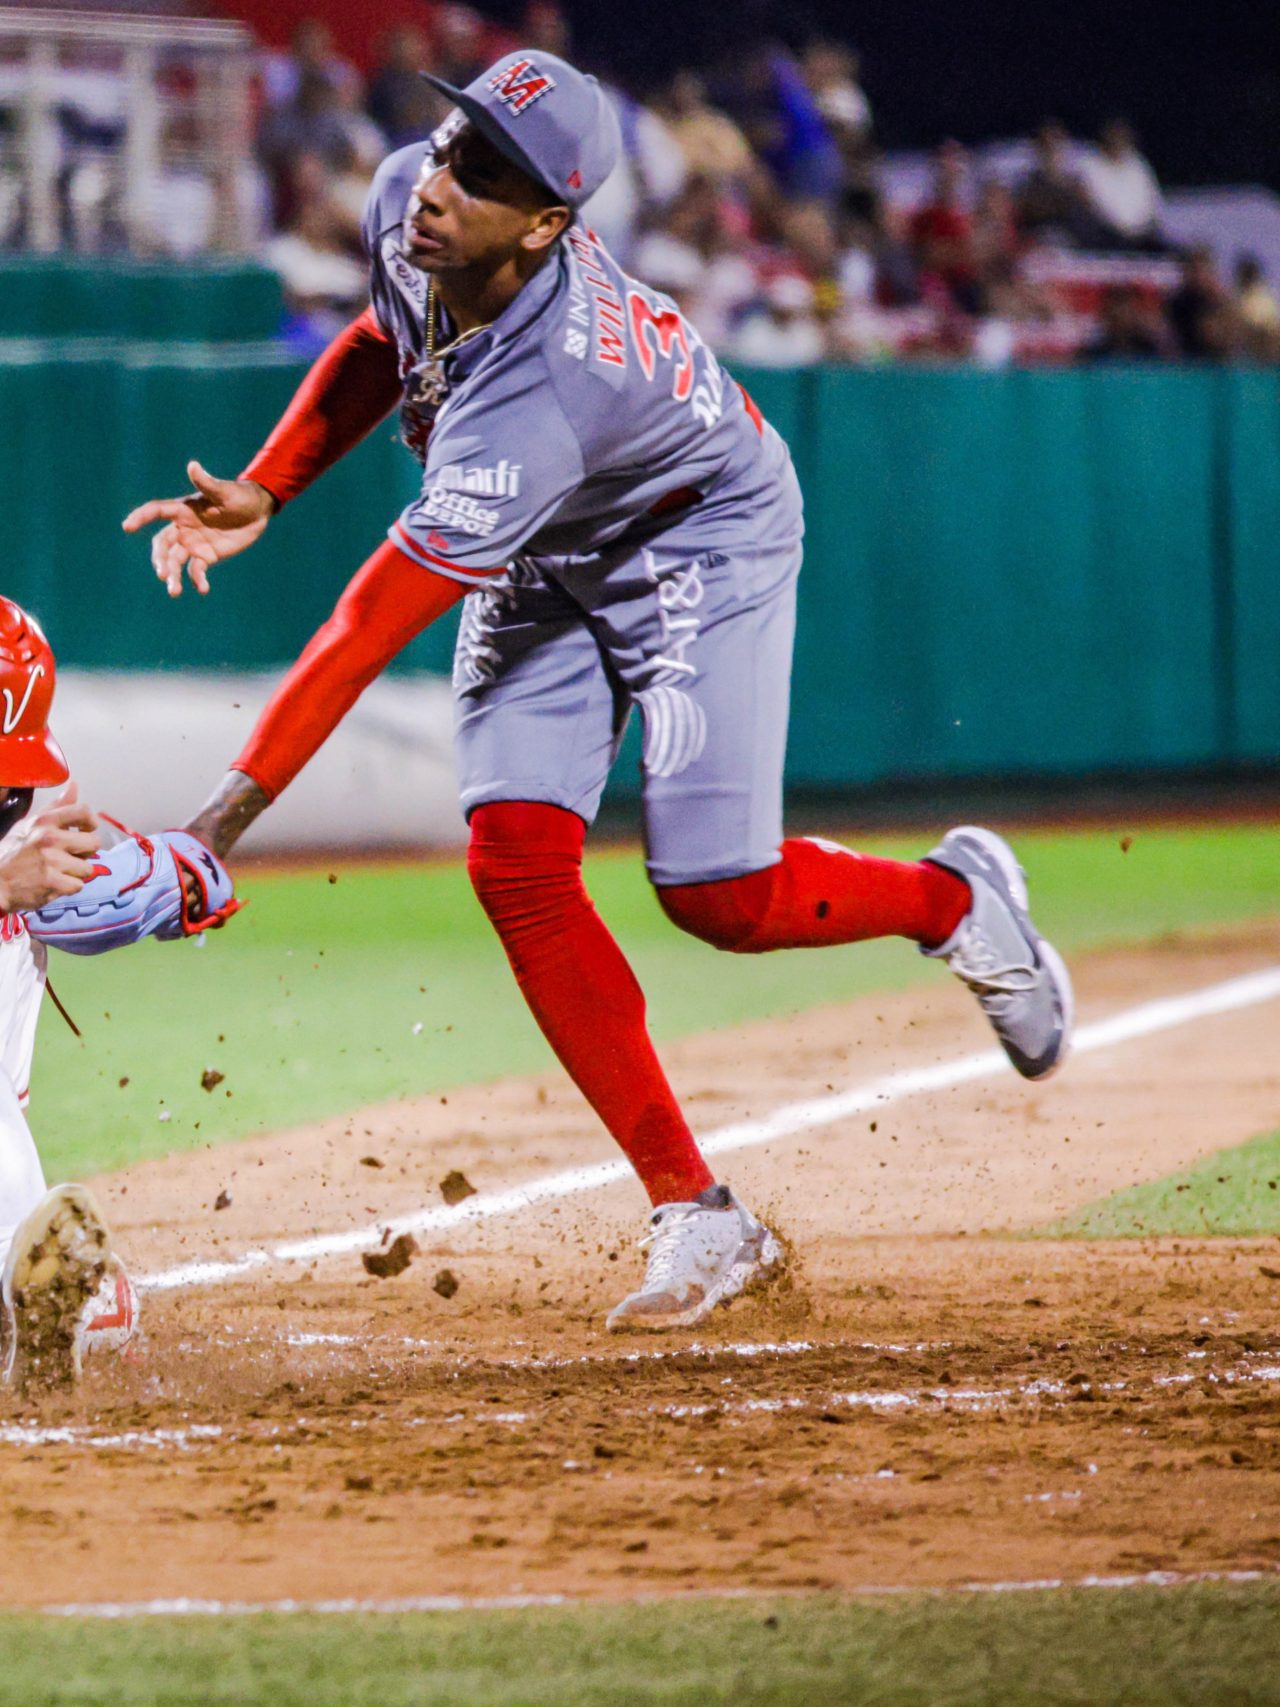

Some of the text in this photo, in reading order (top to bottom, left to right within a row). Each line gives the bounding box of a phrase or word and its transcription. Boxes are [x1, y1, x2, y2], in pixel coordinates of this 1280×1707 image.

[486, 58, 557, 116] M
[428, 487, 500, 525] Office
[641, 548, 705, 677] AT&T
[2, 663, 46, 735] V
